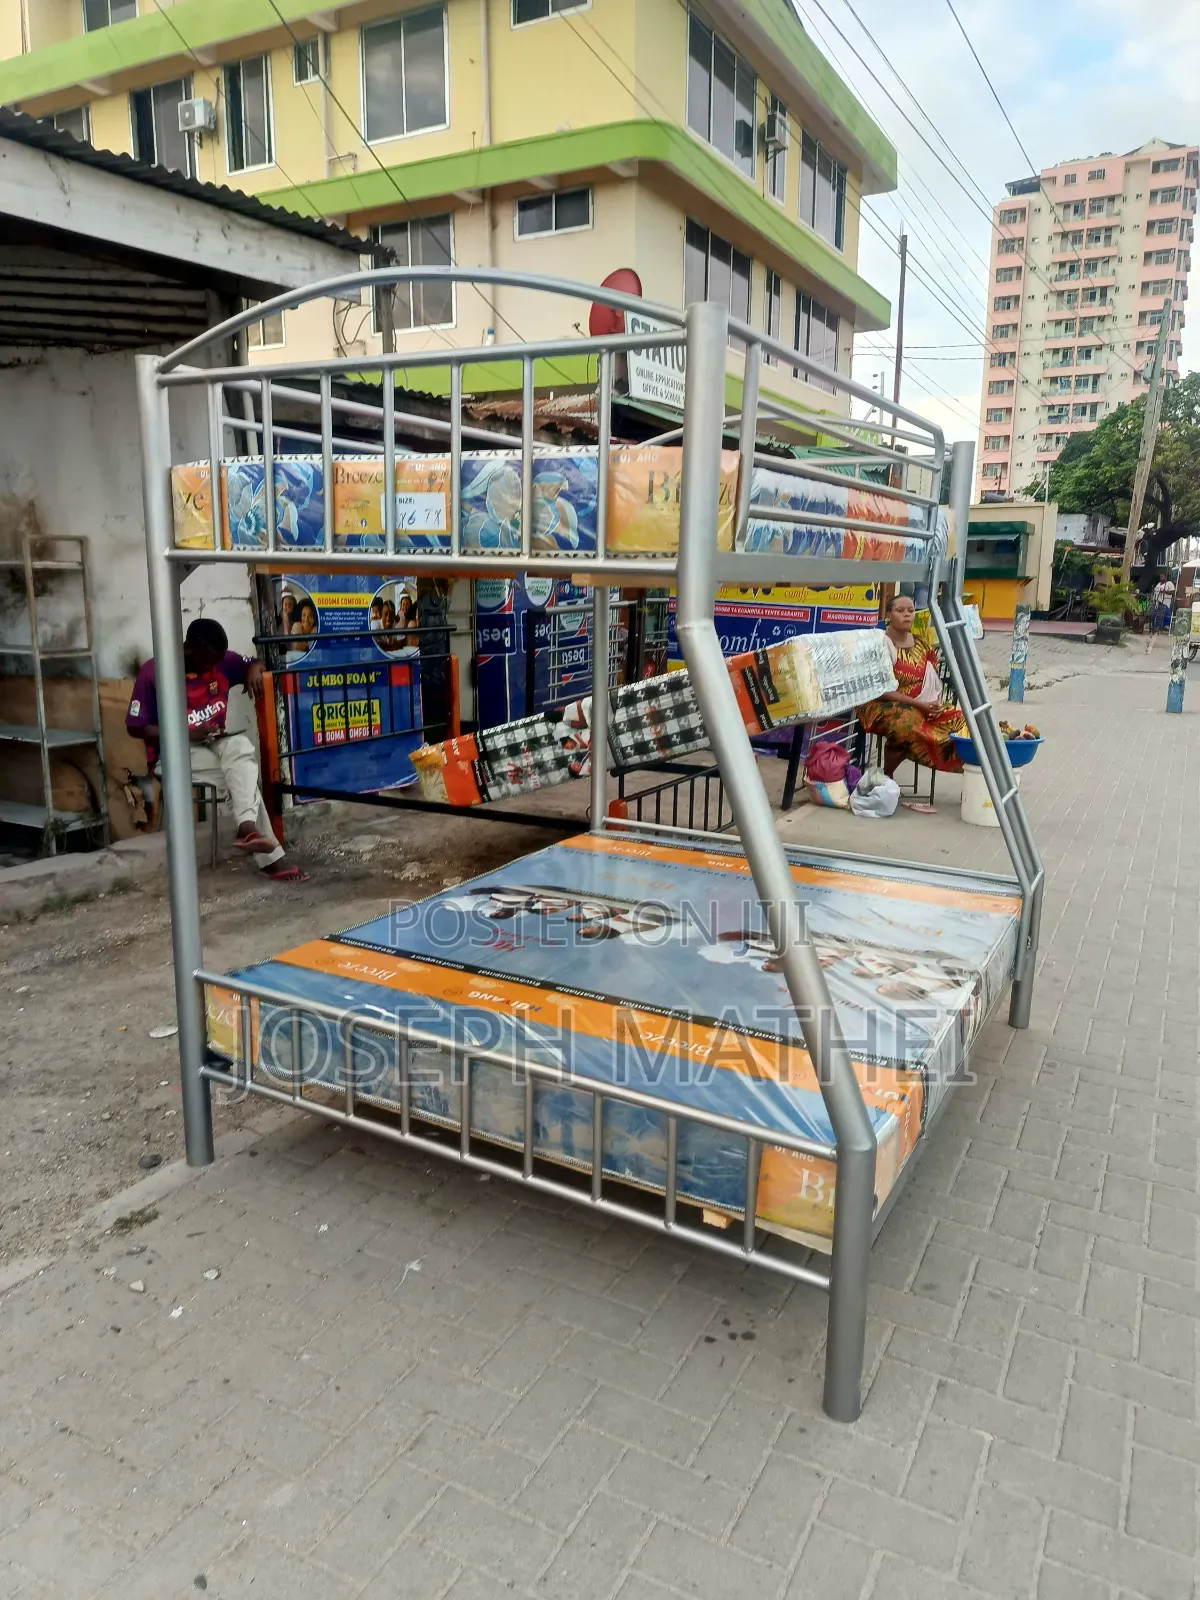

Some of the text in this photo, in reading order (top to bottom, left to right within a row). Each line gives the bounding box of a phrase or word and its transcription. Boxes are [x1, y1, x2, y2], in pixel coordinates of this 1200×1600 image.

[636, 366, 654, 381] ONLINE
[642, 382, 659, 397] OFFICE
[334, 467, 384, 485] Breeze
[784, 586, 854, 607] comfy comfy
[307, 673, 344, 688] JUMBO
[188, 701, 225, 725] akuten
[316, 701, 377, 721] ORIGINAL
[317, 730, 345, 742] DDOMA
[338, 962, 397, 980] Breeze
[555, 986, 605, 1001] Breathable
[712, 1021, 784, 1042] Good support
[640, 1032, 713, 1057] Breeze
